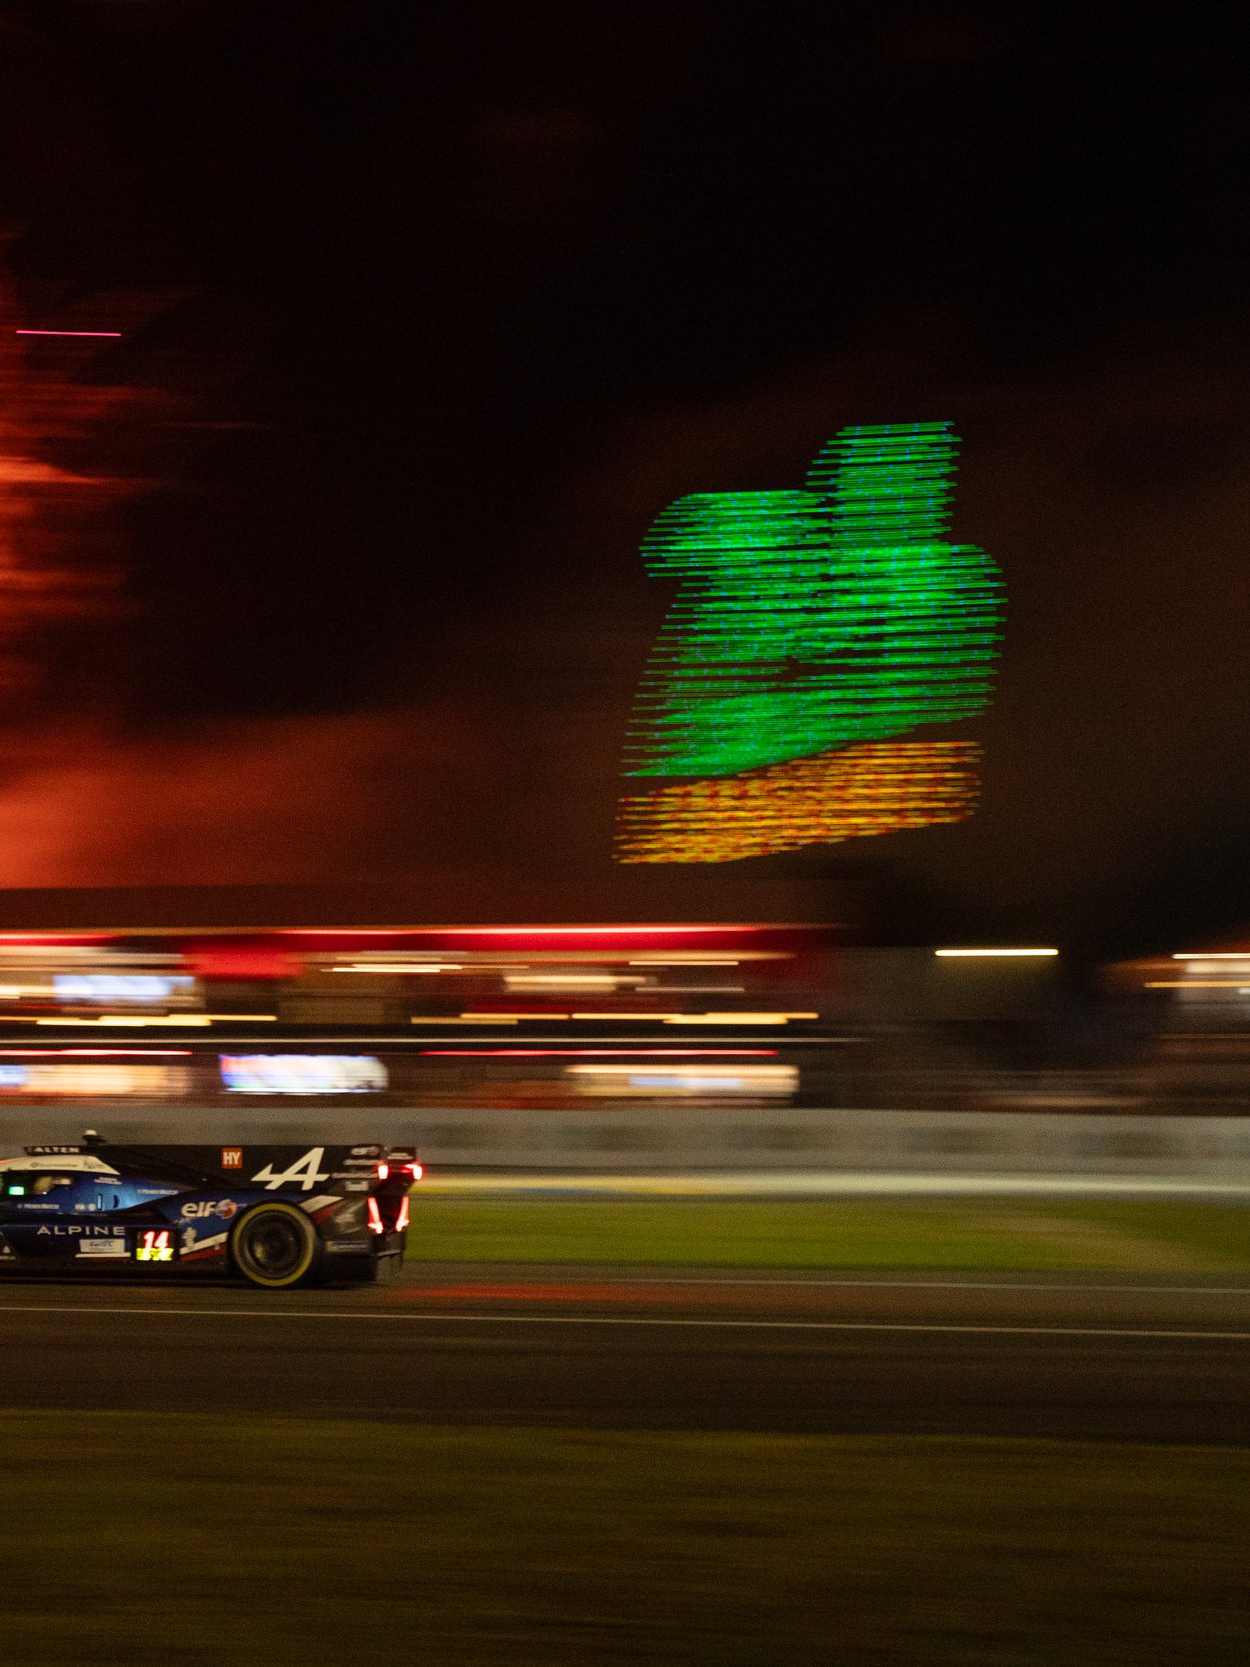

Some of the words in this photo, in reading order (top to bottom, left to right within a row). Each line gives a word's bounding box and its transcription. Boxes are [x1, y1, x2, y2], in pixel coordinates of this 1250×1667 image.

[222, 1150, 242, 1166] HY
[181, 1201, 216, 1218] elf
[36, 1225, 126, 1236] ALPINE
[143, 1230, 170, 1249] 14
